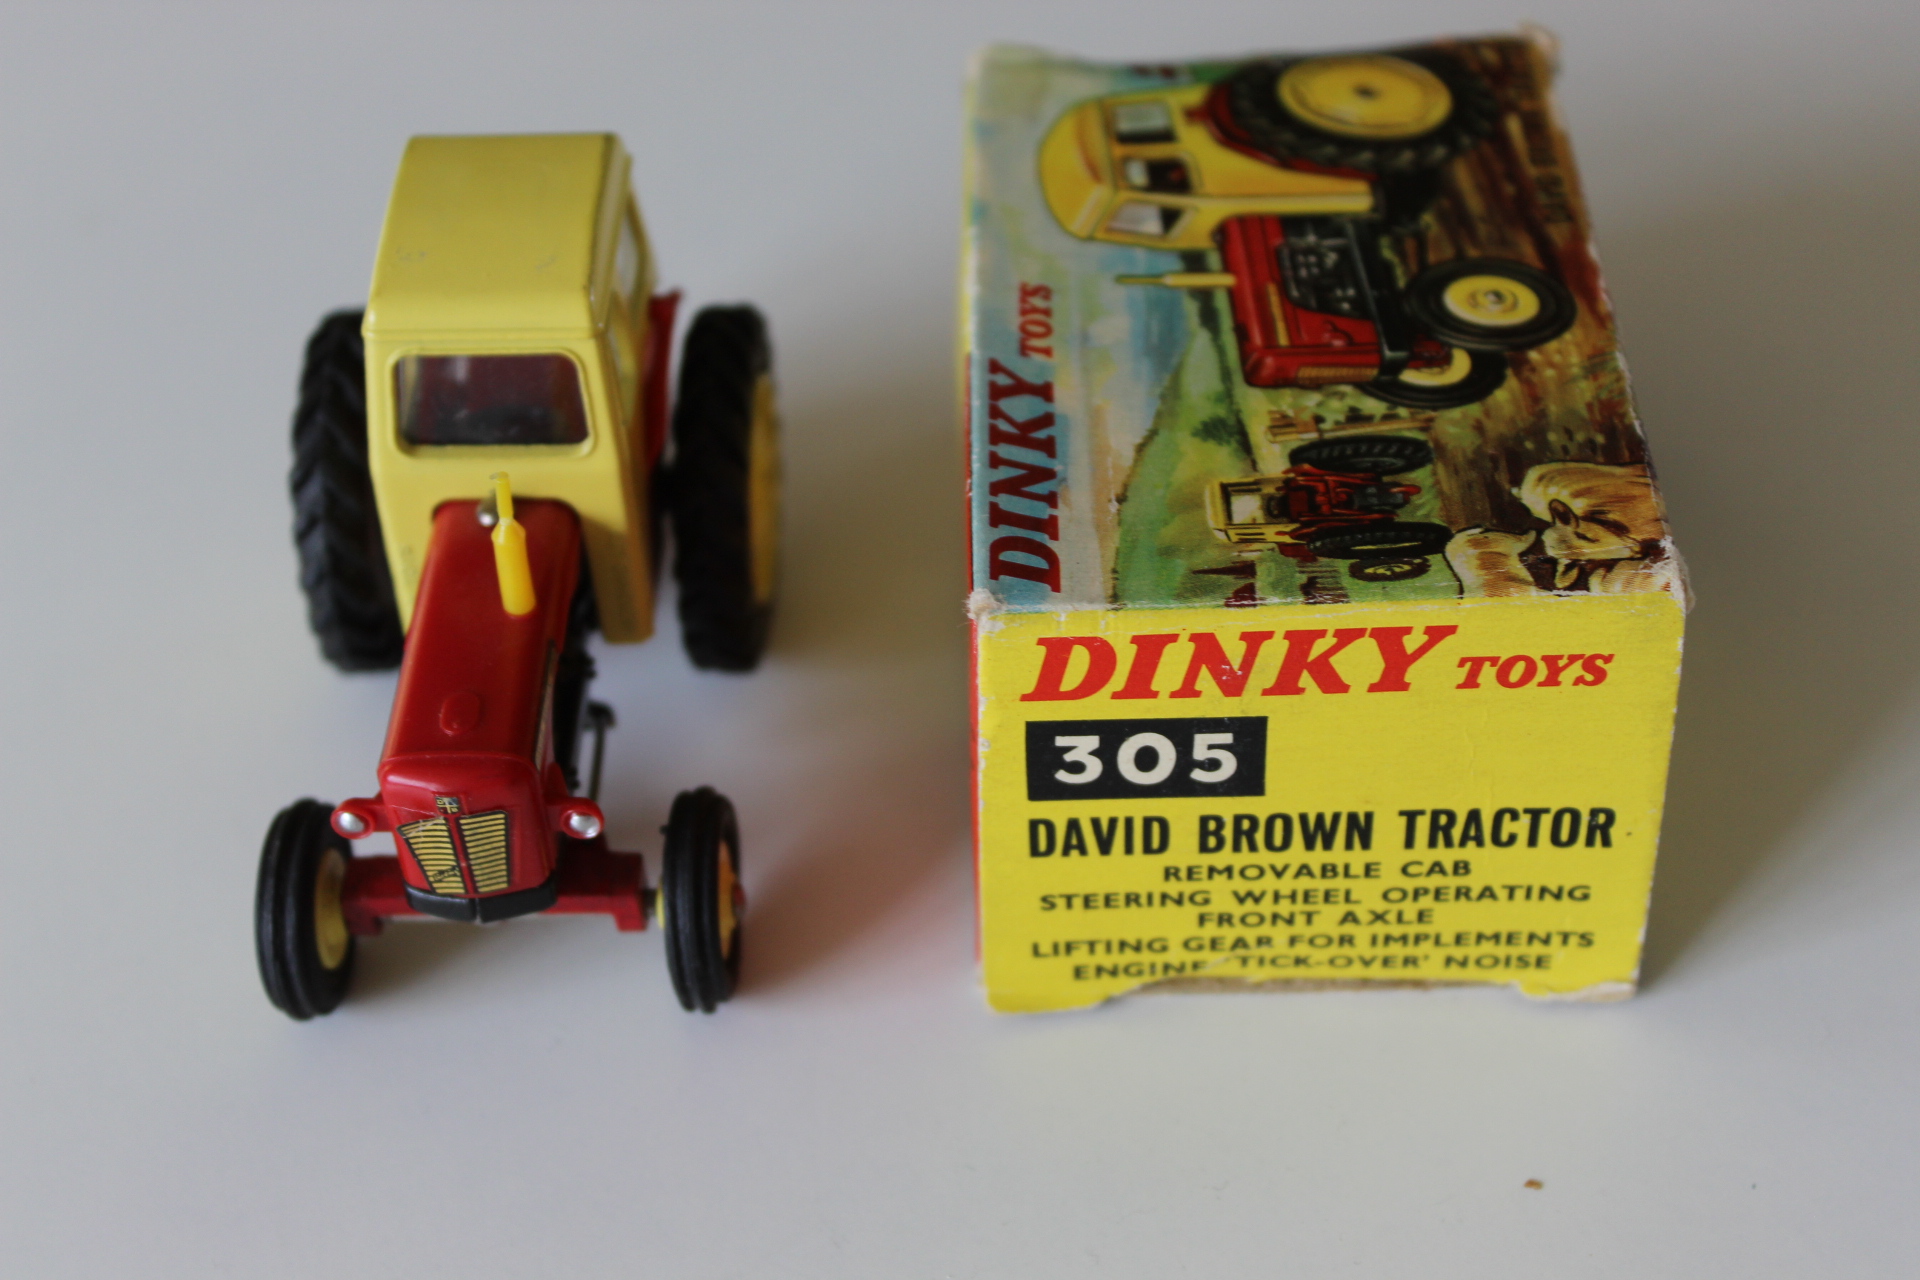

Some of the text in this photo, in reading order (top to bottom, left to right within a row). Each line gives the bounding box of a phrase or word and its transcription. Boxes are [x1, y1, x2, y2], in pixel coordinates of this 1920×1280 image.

[988, 282, 1061, 593] DINKY TOYS
[1020, 624, 1615, 701] DINKY TOYS
[1053, 732, 1239, 786] 305
[1028, 806, 1617, 858] DAVID BROWN TRACTOR
[1163, 860, 1472, 882] REMOVABLE CAB
[1039, 885, 1592, 911] STEERING WHEEL OPERATING
[1198, 908, 1434, 928] FRONT AXLE
[1032, 931, 1595, 958] LIFTING GEAR FOR IMPLEMENTS
[1443, 954, 1553, 970] NOISE
